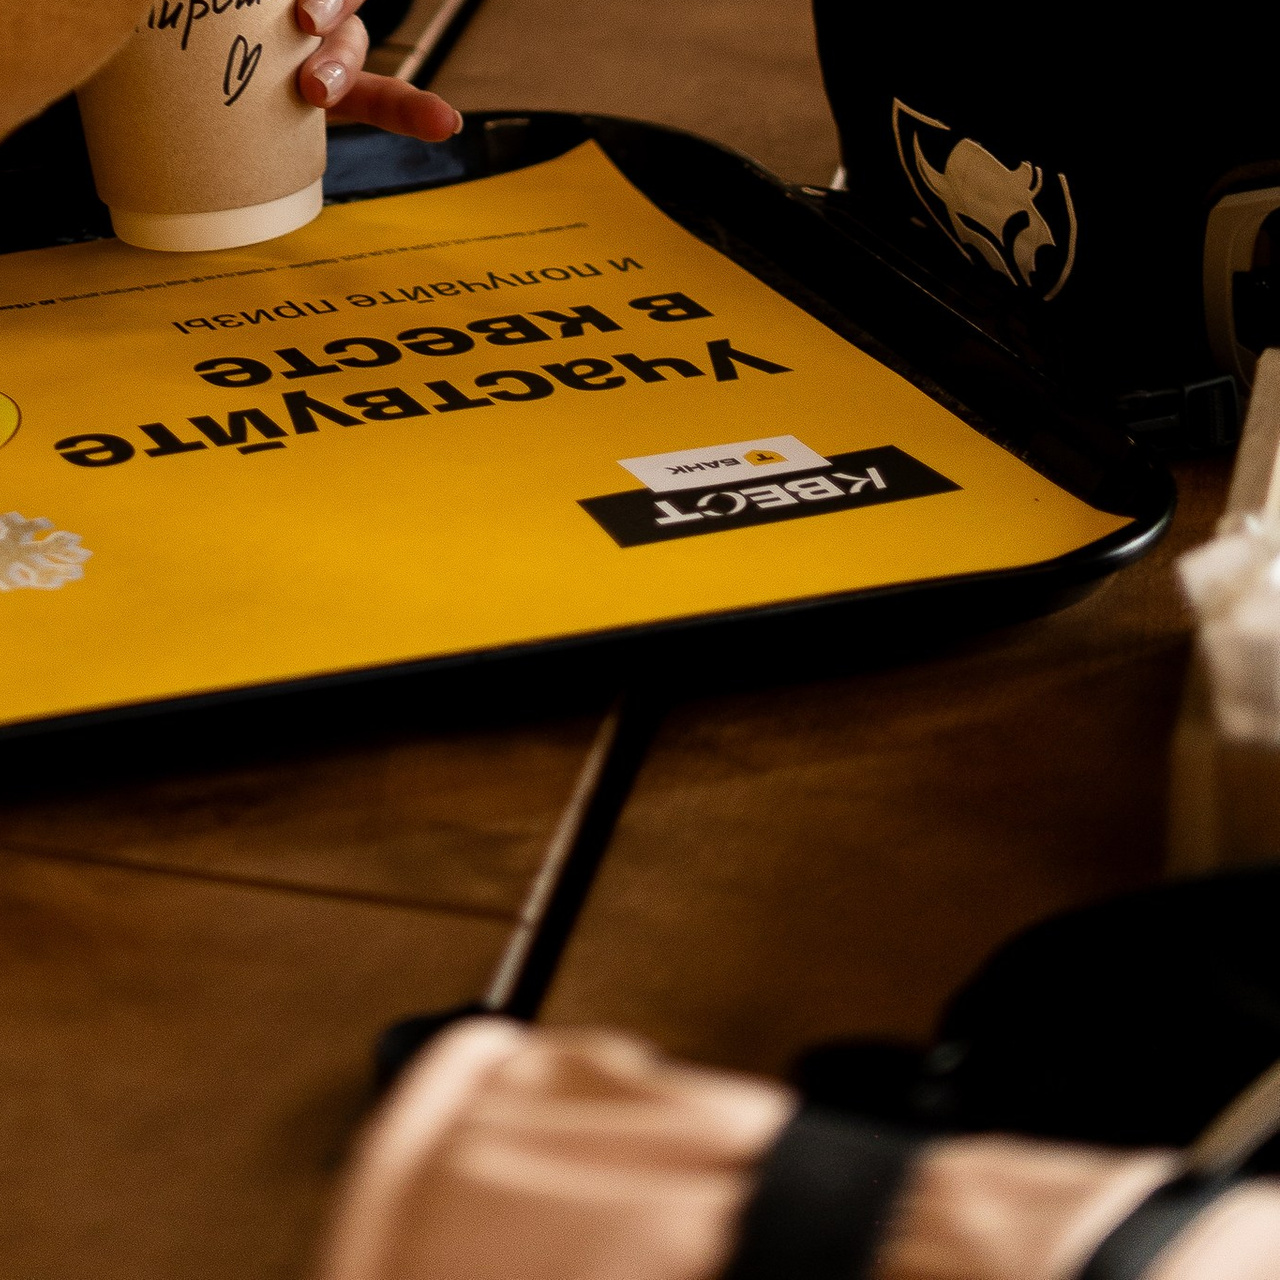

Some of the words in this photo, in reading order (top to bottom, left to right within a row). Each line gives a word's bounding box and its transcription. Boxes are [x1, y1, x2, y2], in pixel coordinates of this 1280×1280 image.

[344, 261, 603, 309] получайте
[607, 256, 645, 272] и
[170, 298, 340, 335] призы
[627, 291, 716, 323] в
[192, 304, 624, 388] квесте
[53, 338, 795, 468] Участвуйте
[664, 456, 742, 477] БАНК
[653, 466, 889, 526] КВЕСТ
